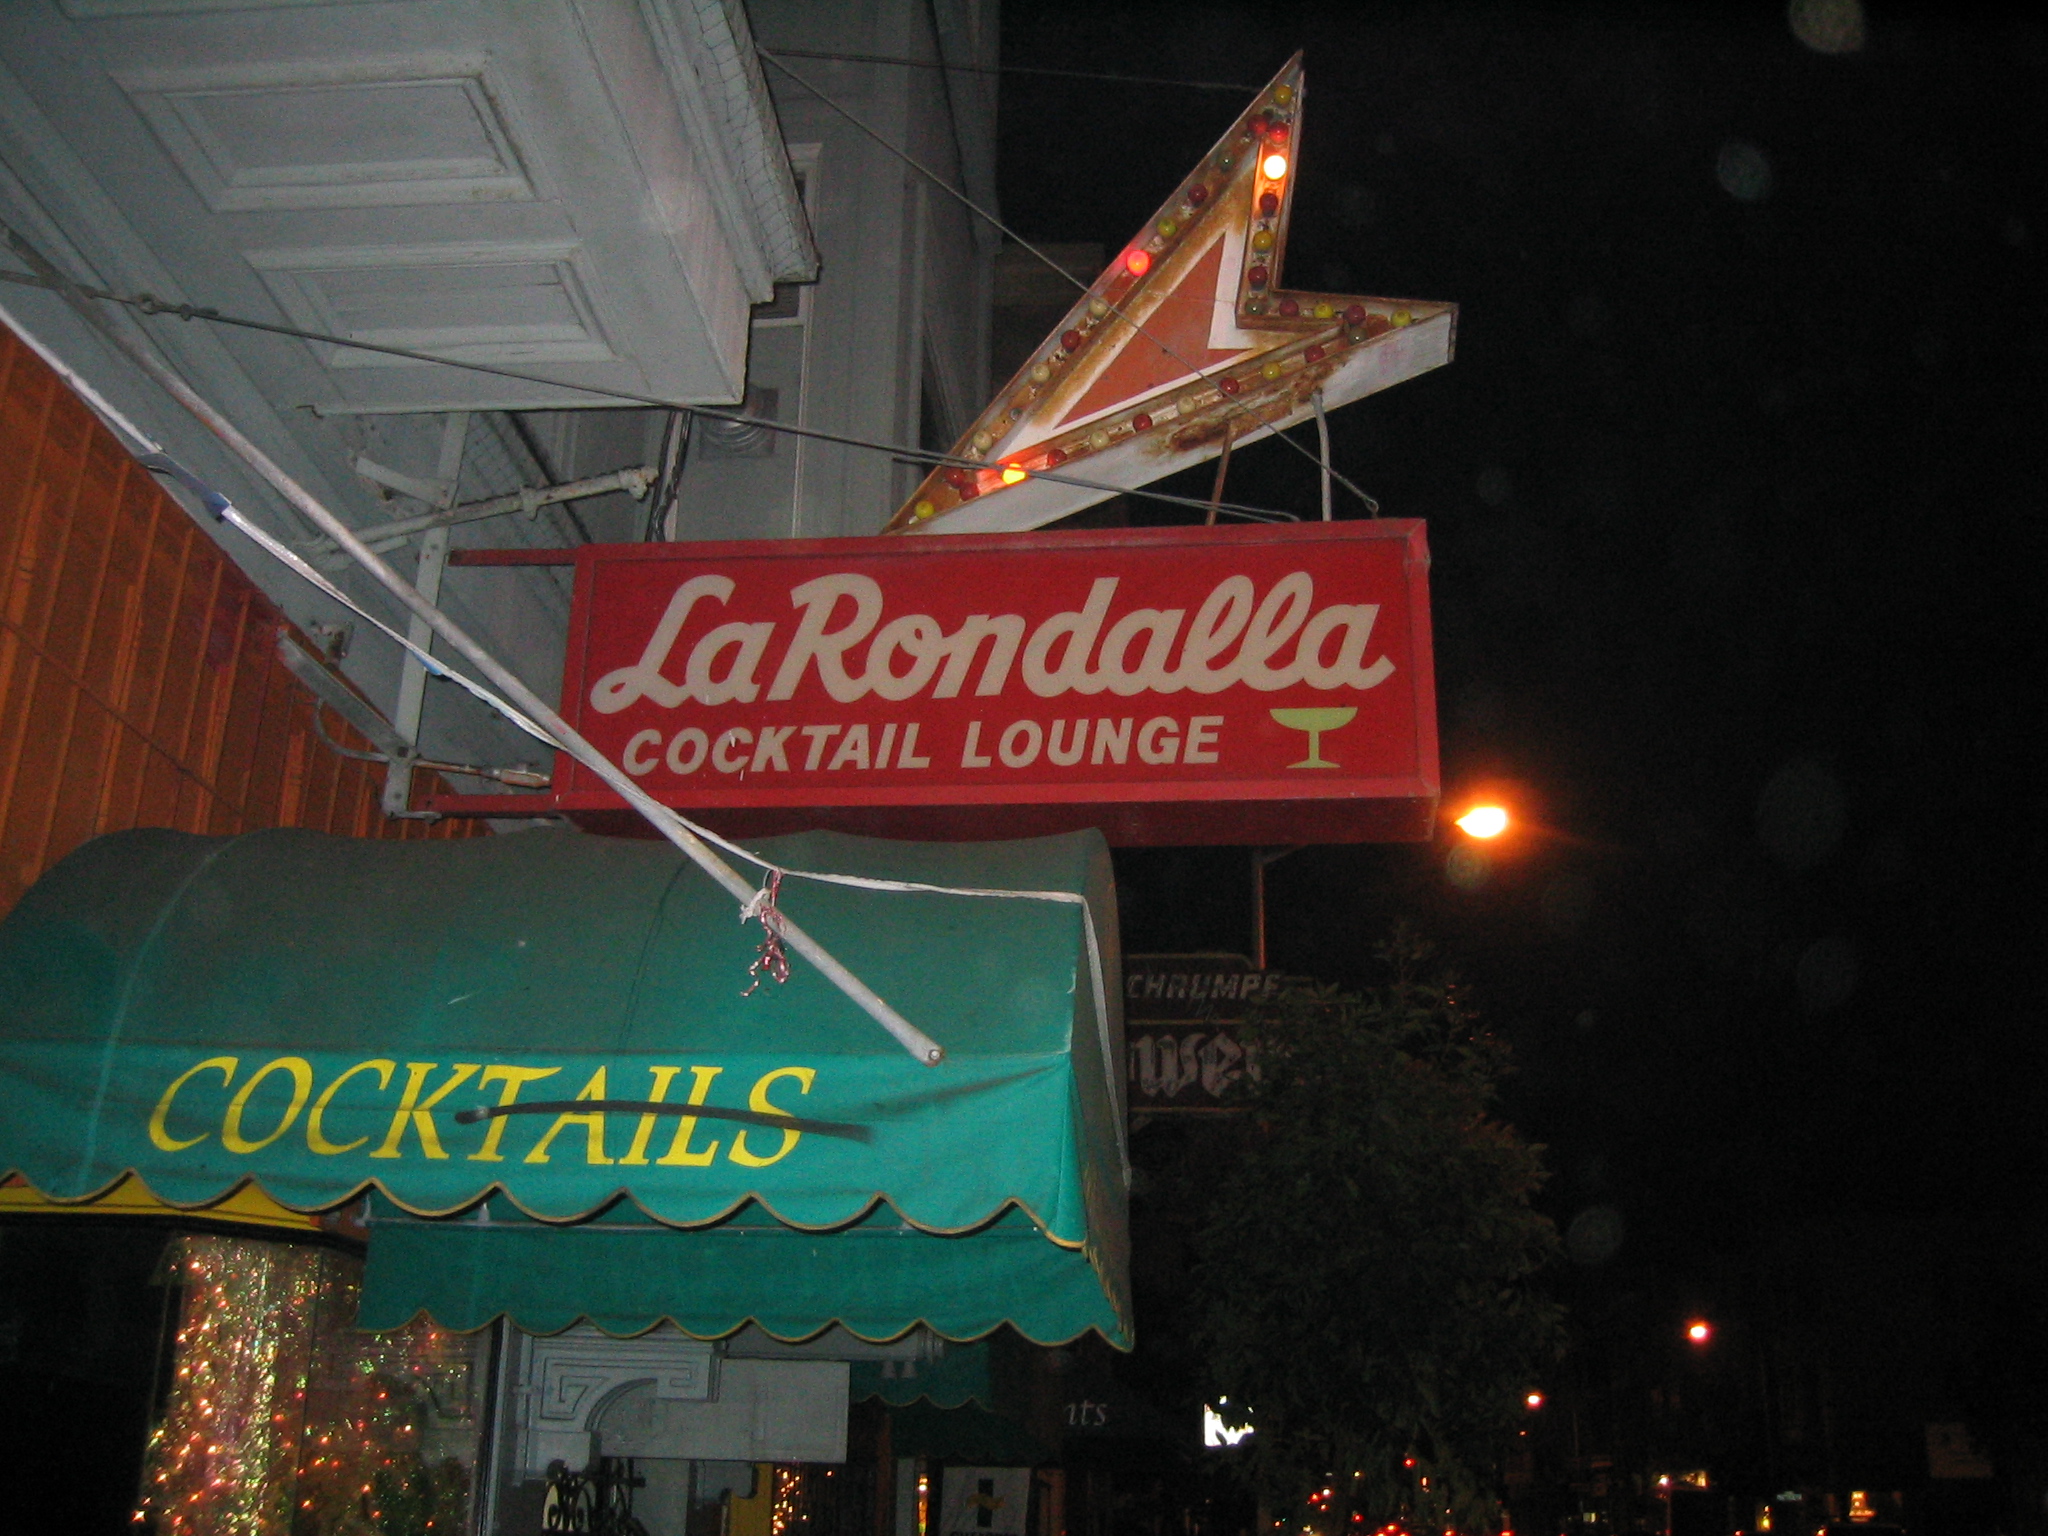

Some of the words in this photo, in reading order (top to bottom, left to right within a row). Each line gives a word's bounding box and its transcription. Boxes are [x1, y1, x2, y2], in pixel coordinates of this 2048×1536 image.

[622, 723, 931, 776] COCKTAIL
[961, 714, 1224, 769] LOUNGE
[147, 1055, 817, 1168] COCKTAILS
